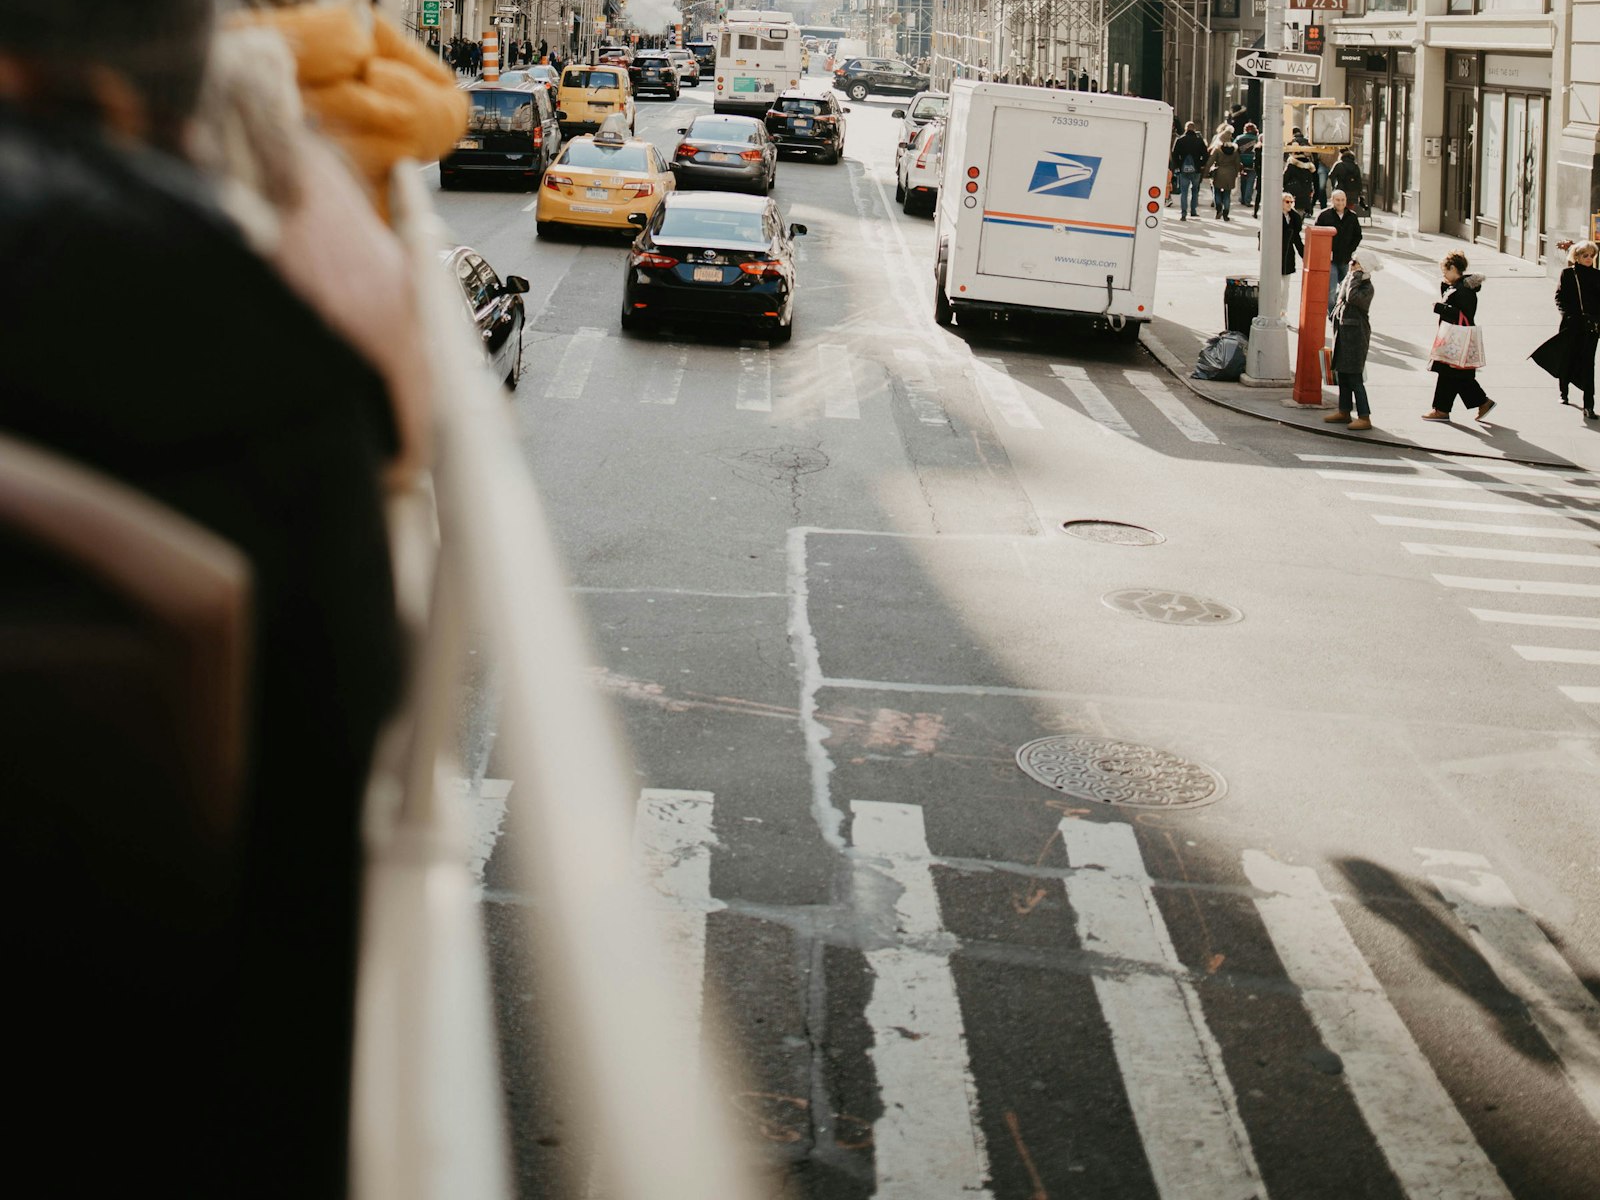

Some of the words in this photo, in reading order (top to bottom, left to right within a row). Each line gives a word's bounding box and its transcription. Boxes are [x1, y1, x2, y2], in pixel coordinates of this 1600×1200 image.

[1246, 58, 1272, 71] ONE
[1286, 62, 1313, 74] WAY
[1051, 116, 1089, 127] 7533930
[1054, 255, 1117, 269] www.usps.com
